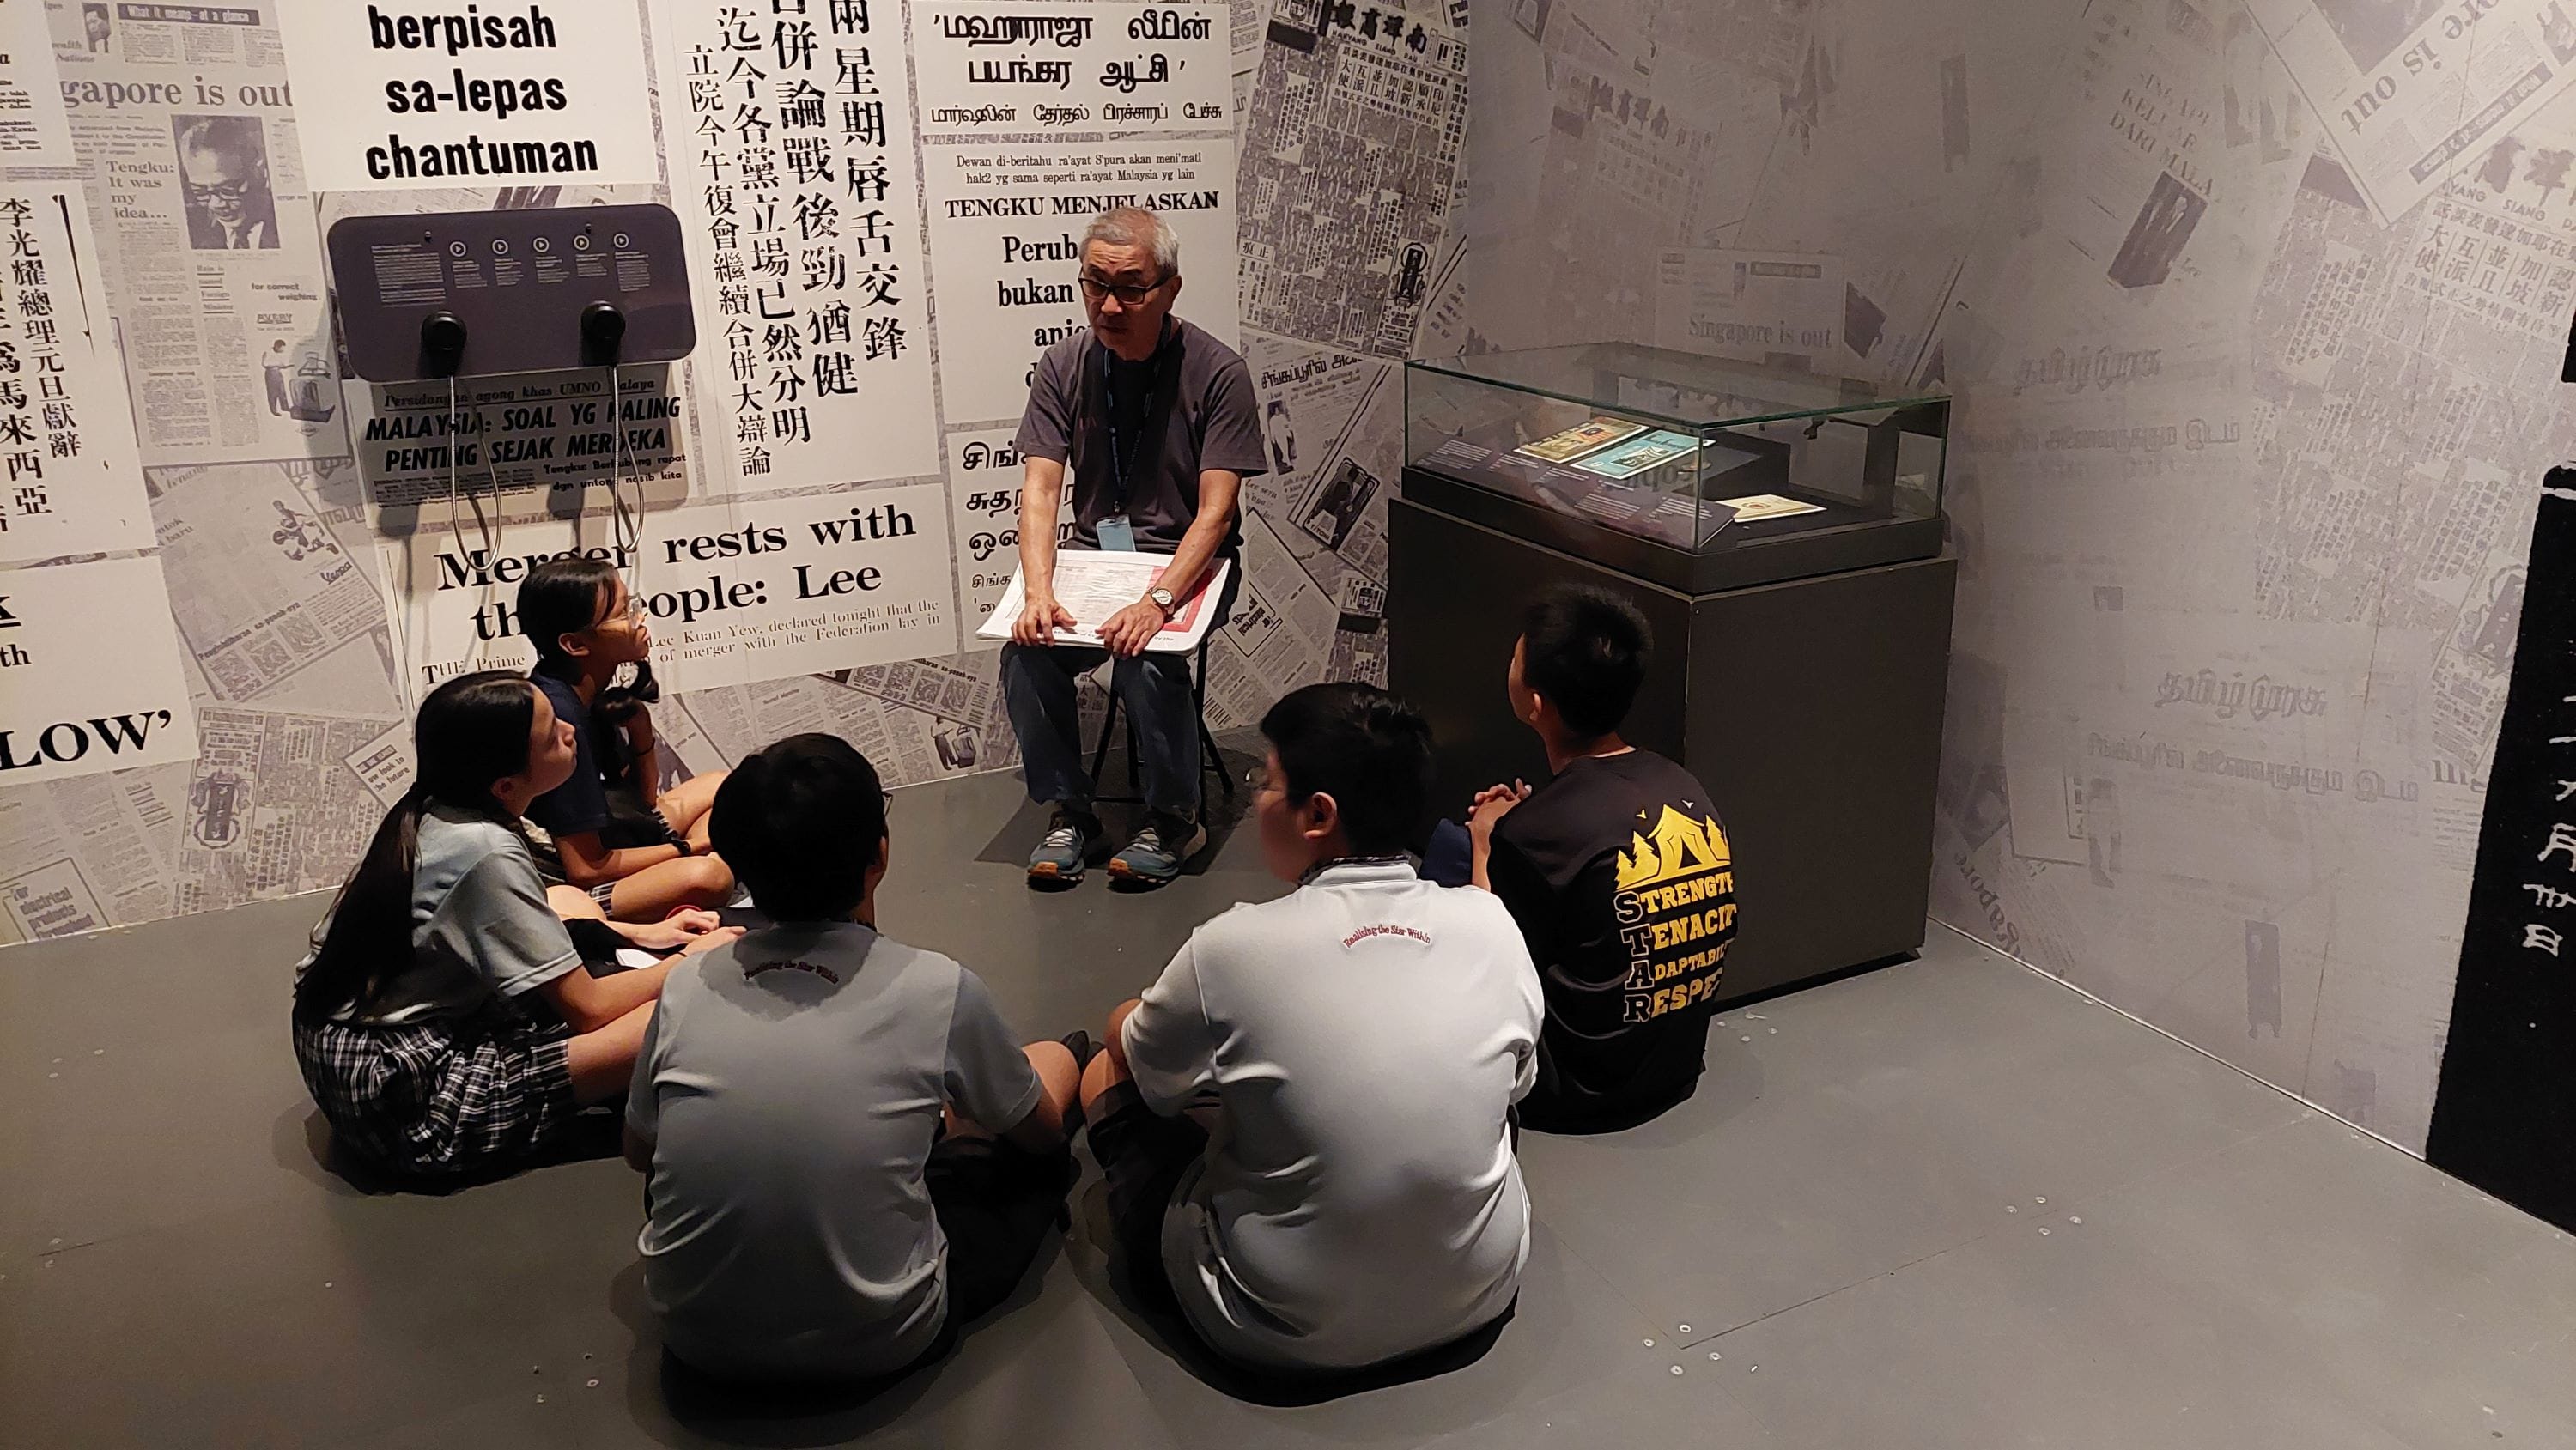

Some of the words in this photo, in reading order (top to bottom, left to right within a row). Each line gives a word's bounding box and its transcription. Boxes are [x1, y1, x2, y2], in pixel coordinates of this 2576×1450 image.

[367, 3, 556, 57] berpisah
[195, 75, 225, 106] is
[238, 80, 294, 108] out
[385, 68, 567, 119] sa-lepas
[2341, 75, 2397, 136] out
[106, 161, 175, 176] Tengku:
[365, 133, 598, 180] chantuman
[957, 155, 992, 167] Dewan
[996, 154, 1052, 167] di-beritahu
[1059, 154, 1091, 167] ra'ayat
[1095, 153, 1127, 167] S'pura
[1129, 152, 1151, 165] akan
[1156, 151, 1202, 164] meni'mati
[108, 175, 125, 189] It
[129, 178, 163, 189] was
[966, 172, 992, 185] hak2
[996, 173, 1009, 185] yg
[1012, 173, 1039, 184] sama
[1043, 171, 1076, 185] seperti
[1080, 170, 1113, 183] ra'ayat
[1117, 169, 1157, 183] Malaysia
[1161, 169, 1174, 181] yg
[1177, 168, 1195, 179] lain
[111, 193, 137, 206] my
[945, 197, 1045, 218] TENGKU
[2502, 199, 2546, 222] SIANG
[716, 7, 811, 446] 迄今各黨立場已然分明
[997, 278, 1074, 307] bukan
[1687, 315, 1774, 347] Singapore
[1779, 319, 1795, 345] is
[1801, 328, 1832, 349] out
[475, 390, 515, 403] agong
[522, 384, 554, 397] khas
[560, 381, 601, 396] UMNO
[611, 378, 655, 391] alaya
[365, 411, 492, 442] MALAYSIA:
[501, 406, 557, 431] SOAL
[570, 403, 596, 427] YG
[385, 442, 477, 472] PENTING
[489, 437, 554, 464] SEJAK
[657, 453, 687, 465] rapat
[552, 481, 574, 492] dgn
[661, 470, 683, 481] kita
[434, 543, 633, 592] Merer
[662, 521, 787, 565] rests
[808, 503, 917, 547] with
[470, 600, 526, 641] th
[635, 574, 768, 623] ople:
[792, 563, 882, 601] Lee
[659, 648, 676, 663] of
[683, 642, 737, 660] merger
[744, 635, 777, 652] with
[785, 631, 808, 646] the
[816, 620, 890, 642] Federation
[927, 612, 941, 627] in
[683, 629, 723, 646] Kuan
[769, 613, 827, 634] declared
[833, 607, 882, 628] tonight
[886, 603, 913, 617] that
[918, 598, 939, 614] the
[476, 654, 526, 673] Prime
[1343, 925, 1378, 949] Realising
[1378, 924, 1390, 934] the
[1391, 925, 1407, 936] Star
[1407, 927, 1431, 943] Within
